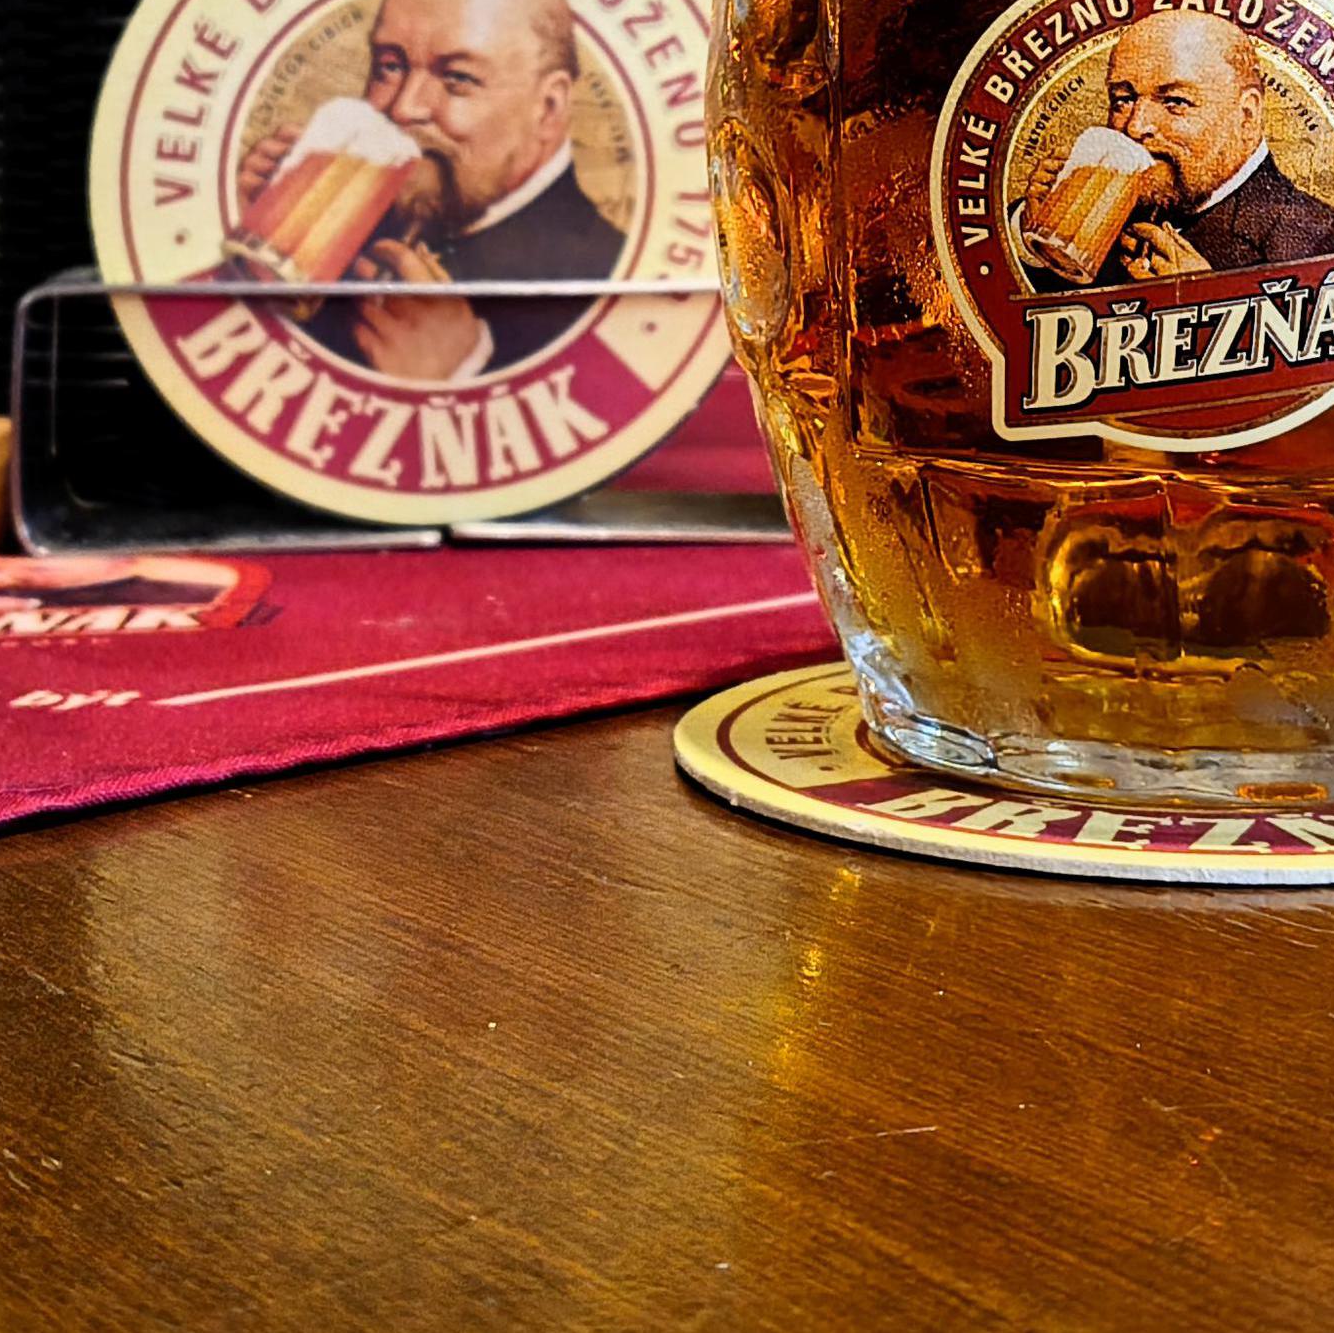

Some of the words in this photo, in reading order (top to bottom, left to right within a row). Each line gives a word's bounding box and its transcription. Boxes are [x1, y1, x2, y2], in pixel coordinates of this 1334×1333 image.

[154, 15, 237, 207] VELKÉ
[958, 114, 998, 248] VELKÉ
[1023, 112, 1052, 157] VIKTOR
[1048, 75, 1086, 113] CIBICH
[176, 302, 609, 489] BŘEZŇÁK
